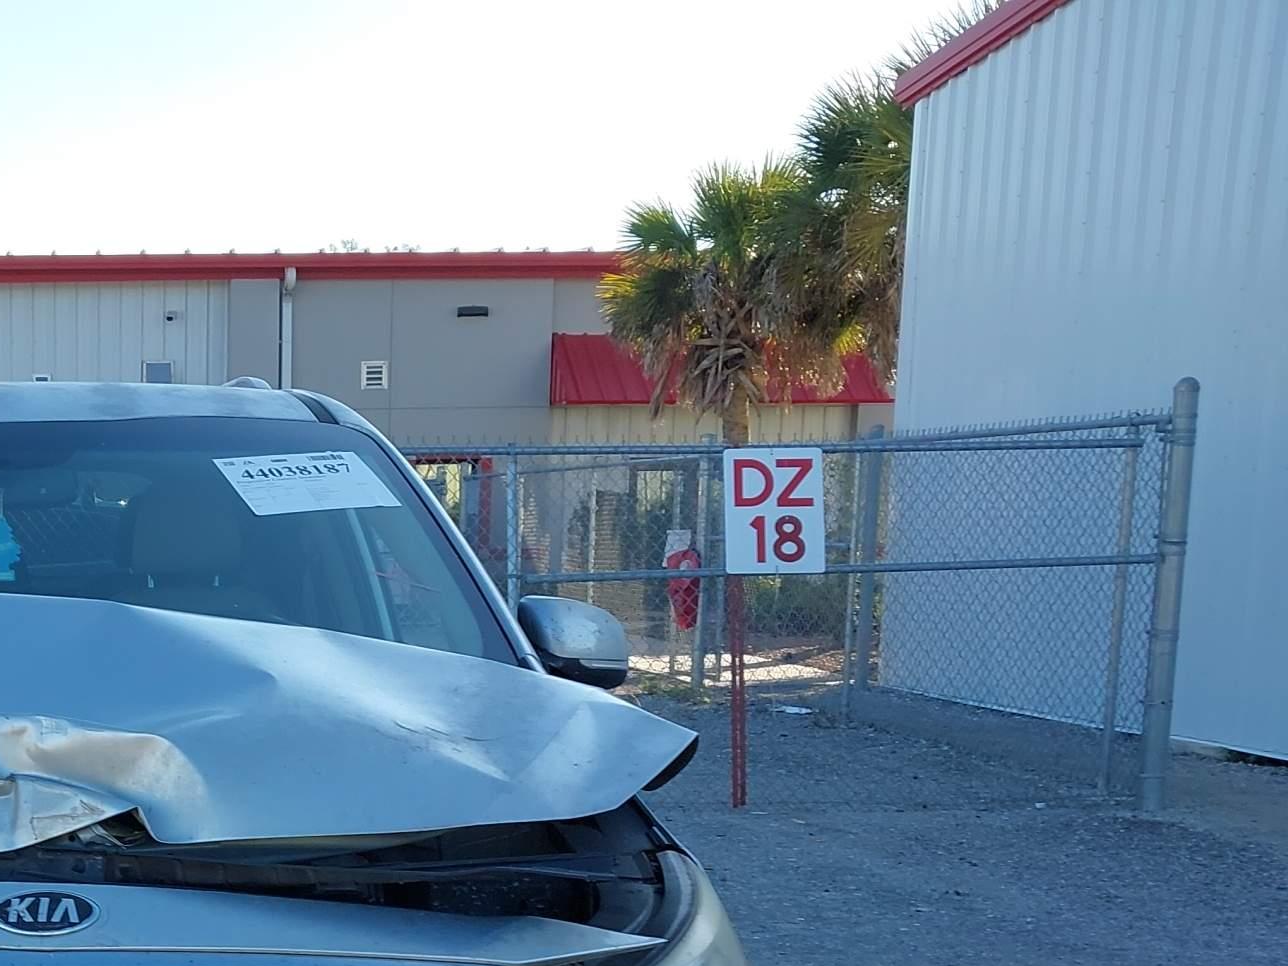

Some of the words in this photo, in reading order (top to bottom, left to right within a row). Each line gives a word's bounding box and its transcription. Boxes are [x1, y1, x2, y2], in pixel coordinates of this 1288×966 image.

[240, 462, 351, 480] 44038187
[733, 458, 814, 507] DZ
[749, 515, 806, 563] 18
[7, 897, 80, 923] KIA
